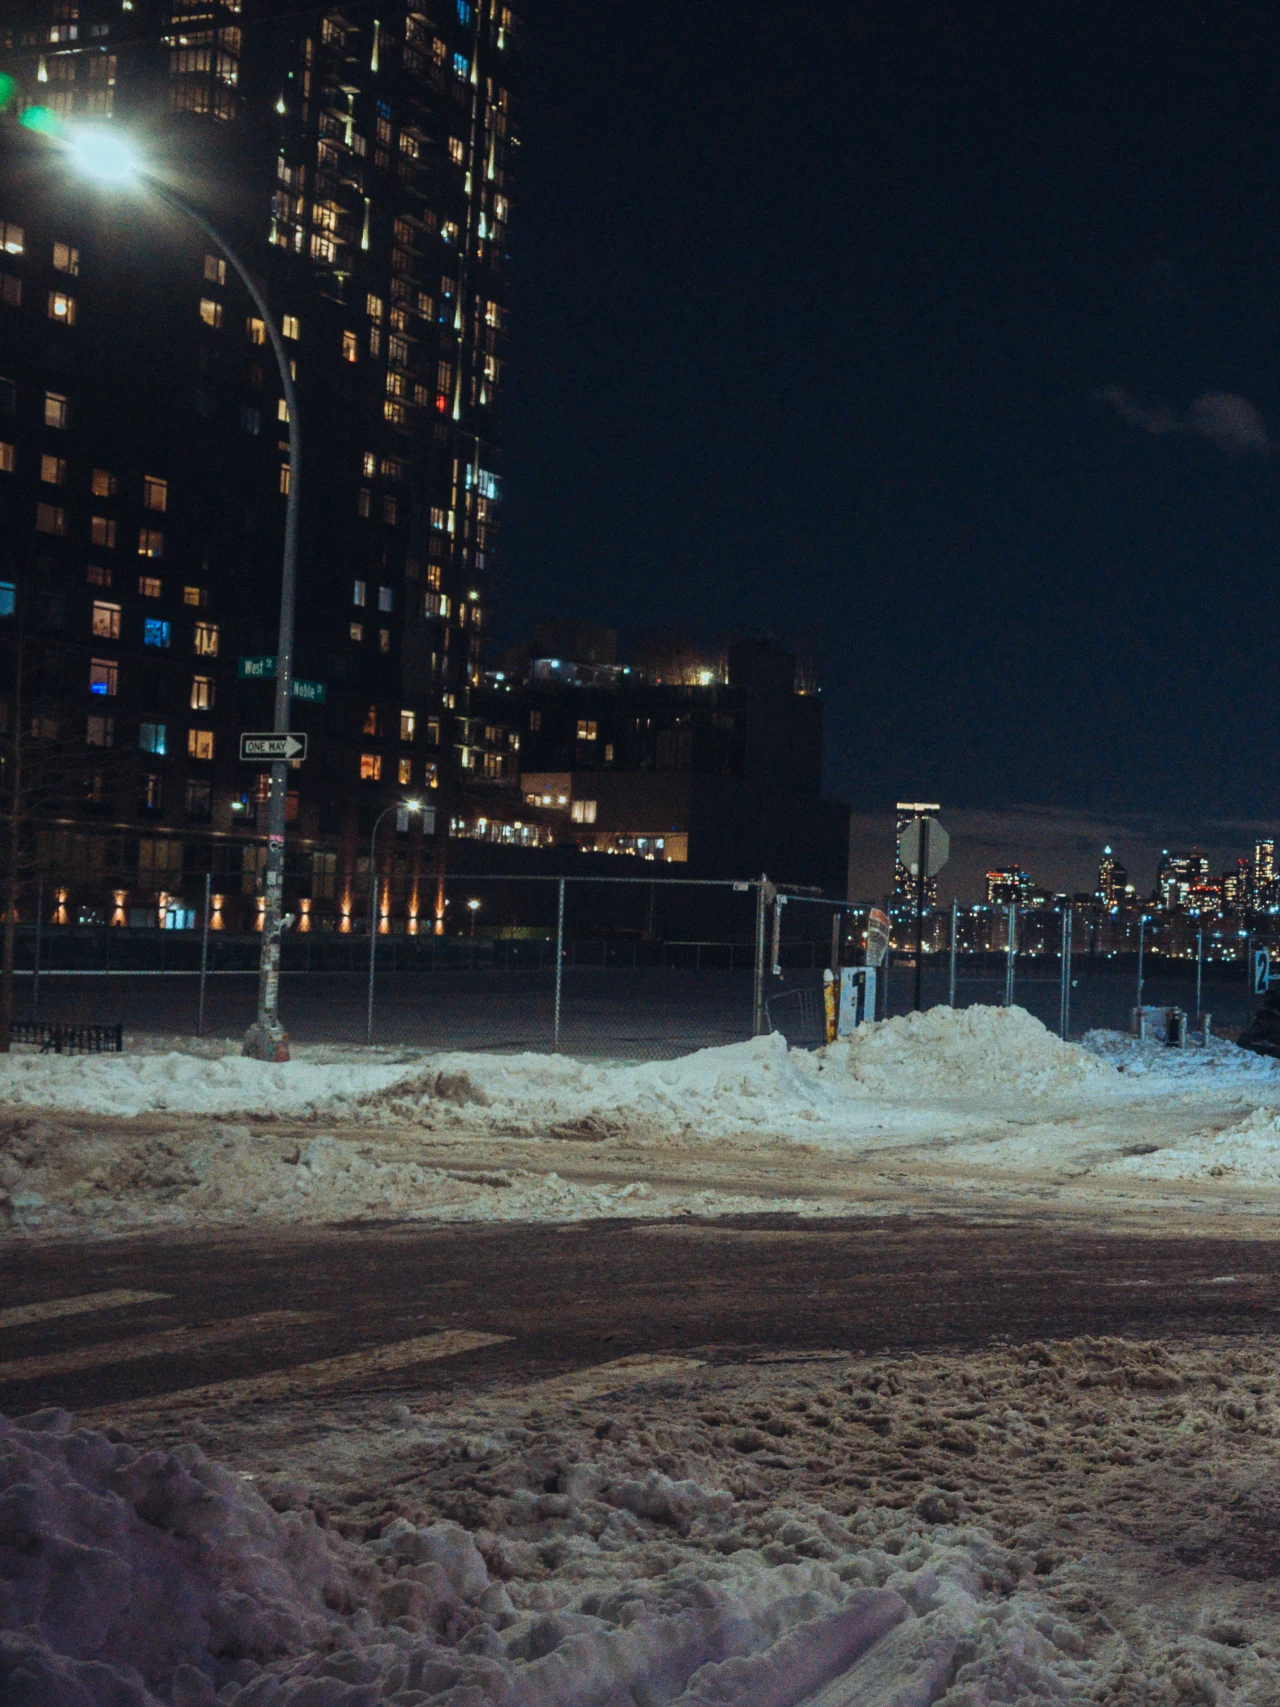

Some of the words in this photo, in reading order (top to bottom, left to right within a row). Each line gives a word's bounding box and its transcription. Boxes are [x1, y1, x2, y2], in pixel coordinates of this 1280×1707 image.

[244, 659, 264, 675] West
[293, 681, 316, 699] Noble
[247, 741, 266, 752] ONE
[268, 741, 287, 751] WAY
[1257, 952, 1267, 991] 2
[852, 971, 866, 1027] 1
